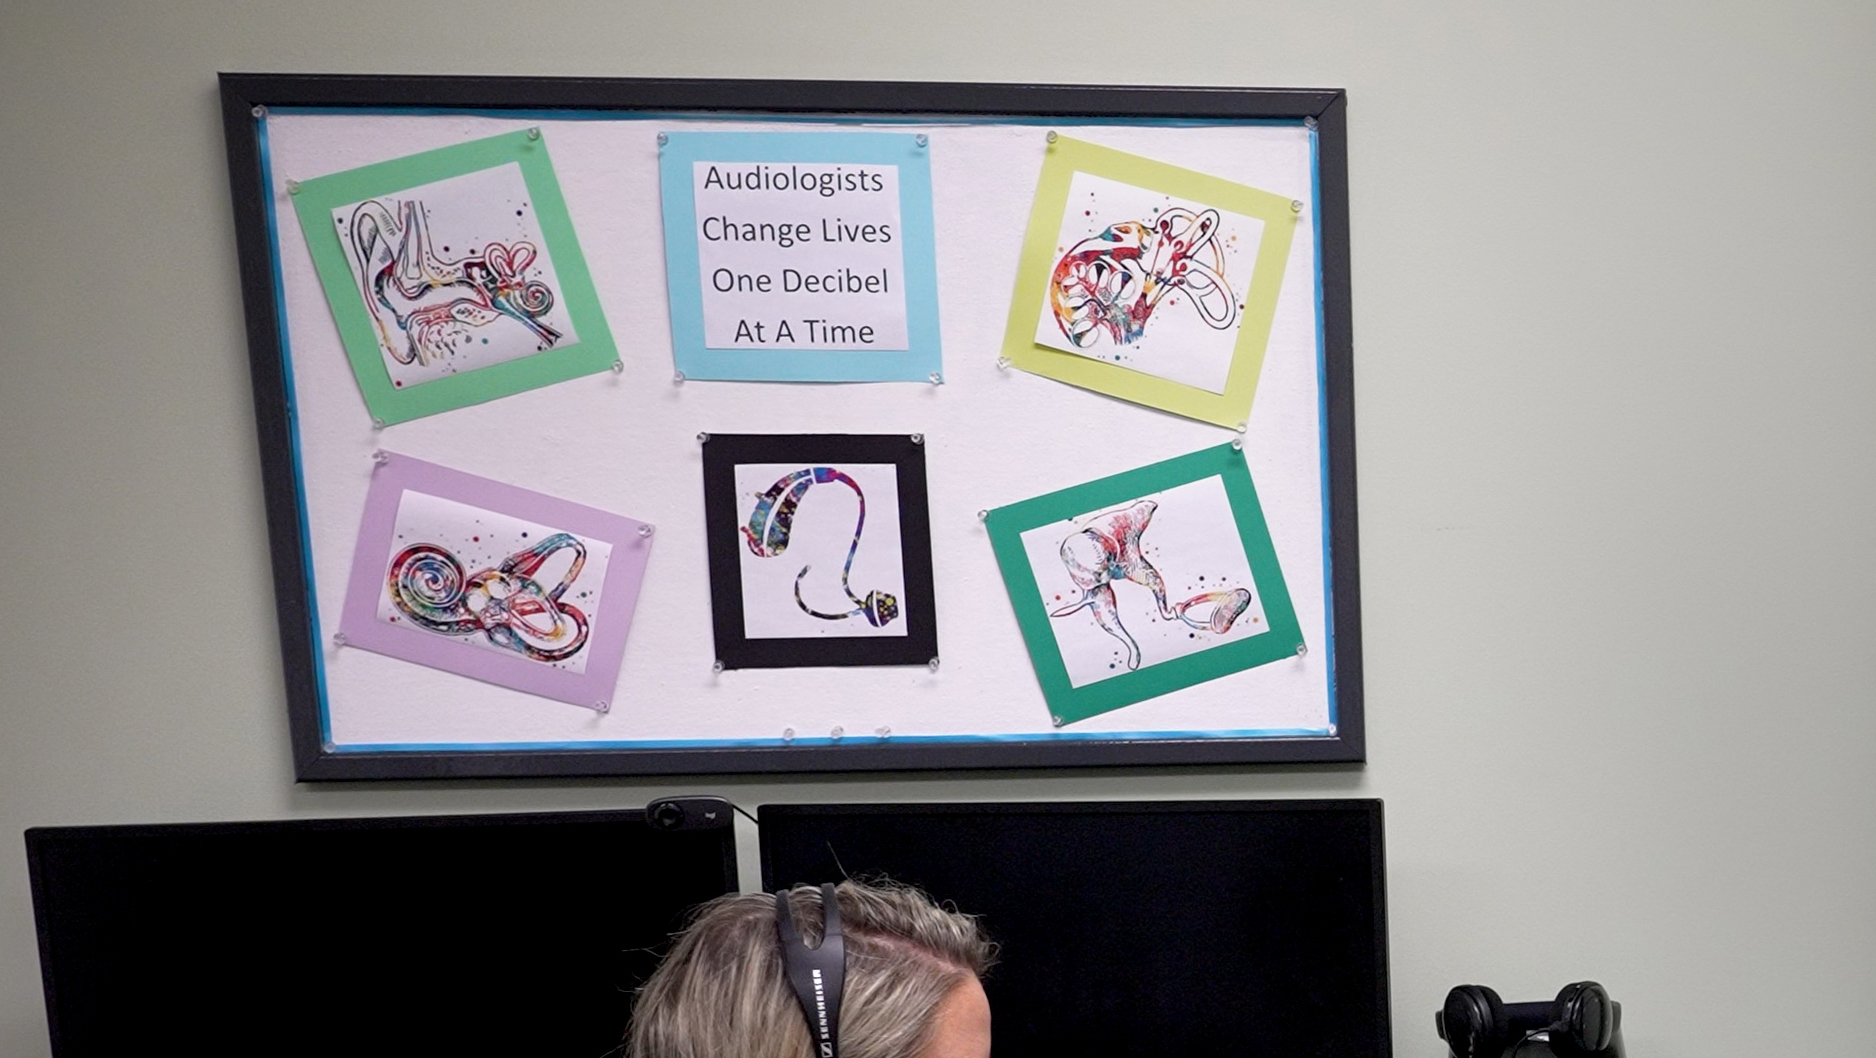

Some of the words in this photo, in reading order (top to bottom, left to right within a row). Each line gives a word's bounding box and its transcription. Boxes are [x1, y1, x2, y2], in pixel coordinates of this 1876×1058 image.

[704, 165, 883, 197] Audiologists
[702, 215, 811, 248] Change
[822, 218, 891, 243] Lives
[712, 268, 771, 293] One
[783, 268, 888, 293] Decibel
[734, 319, 766, 343] At
[775, 319, 795, 343] A
[802, 319, 874, 344] Time
[812, 969, 830, 1040] SENNHEISER
